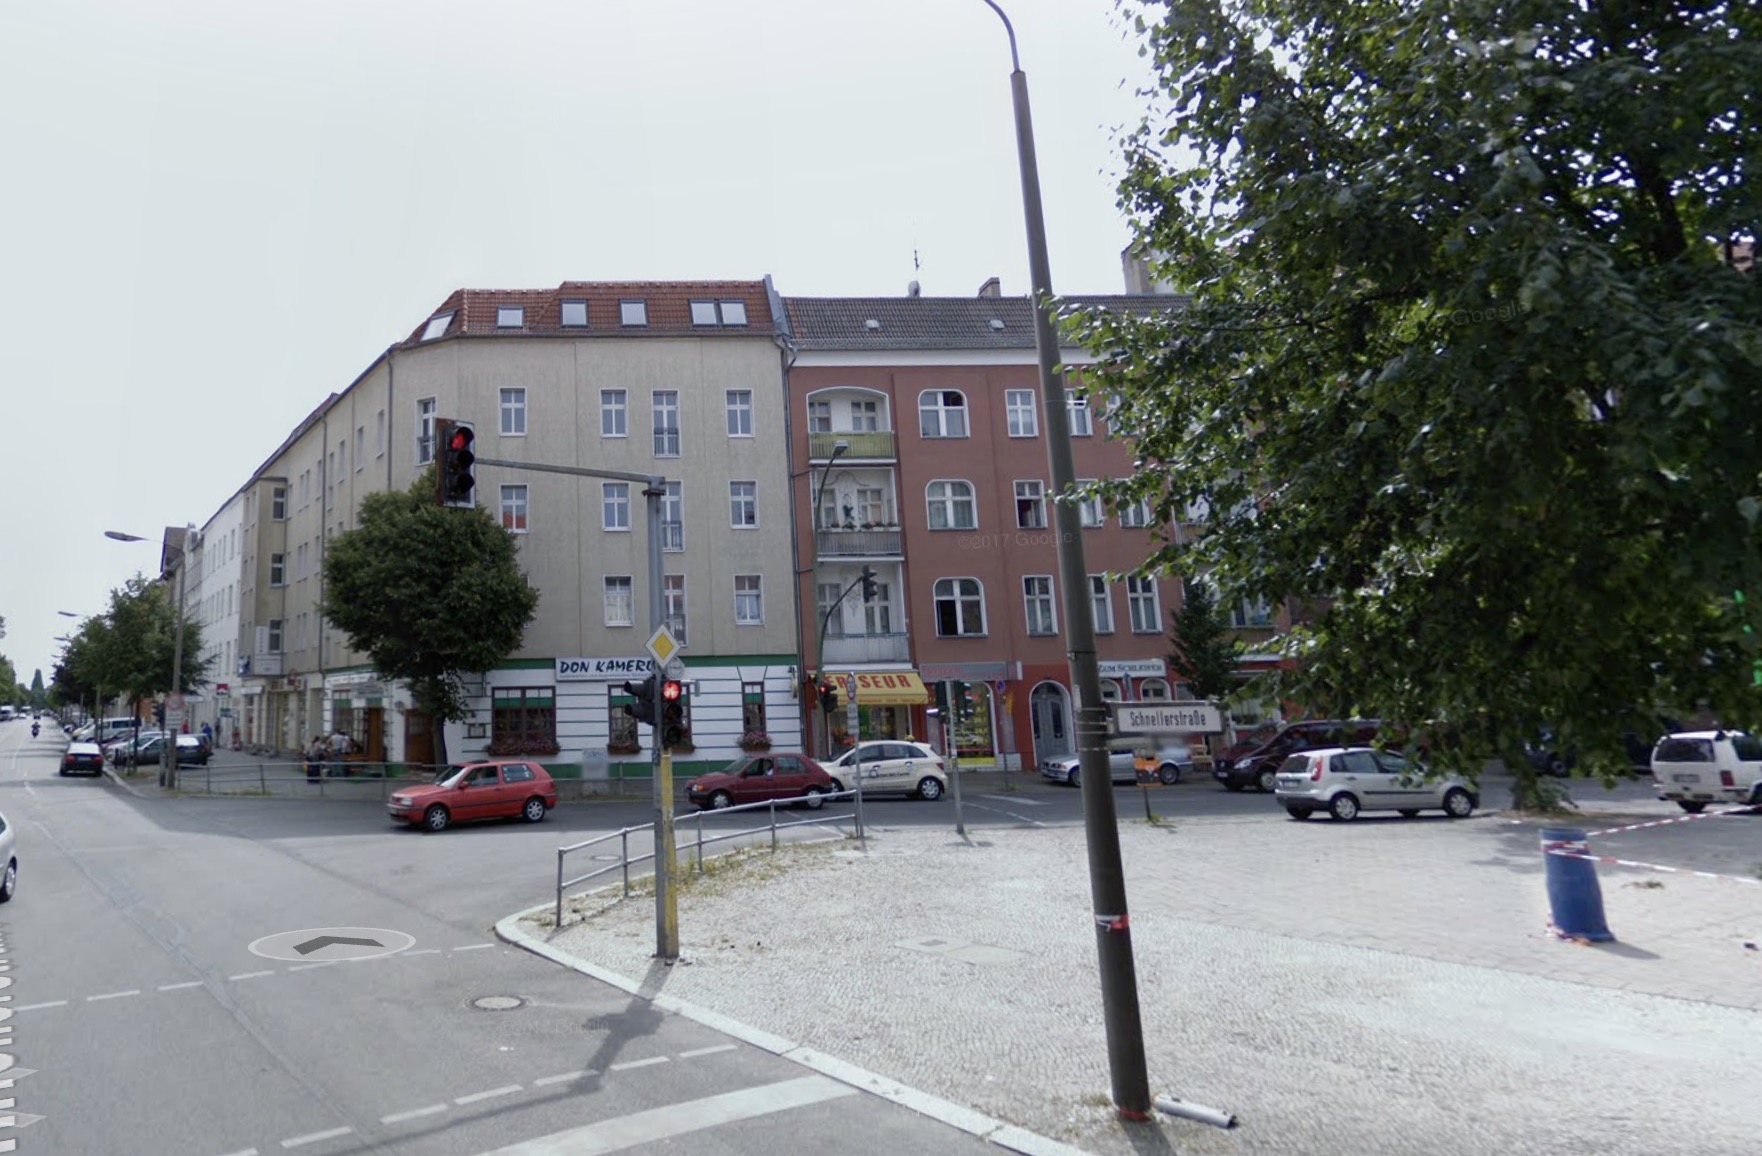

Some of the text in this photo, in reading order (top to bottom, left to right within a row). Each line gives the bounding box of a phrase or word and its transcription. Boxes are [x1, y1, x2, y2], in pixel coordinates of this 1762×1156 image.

[560, 660, 590, 674] DON
[823, 672, 912, 688] FRSEUR
[1129, 709, 1207, 728] Schnellerstraße
